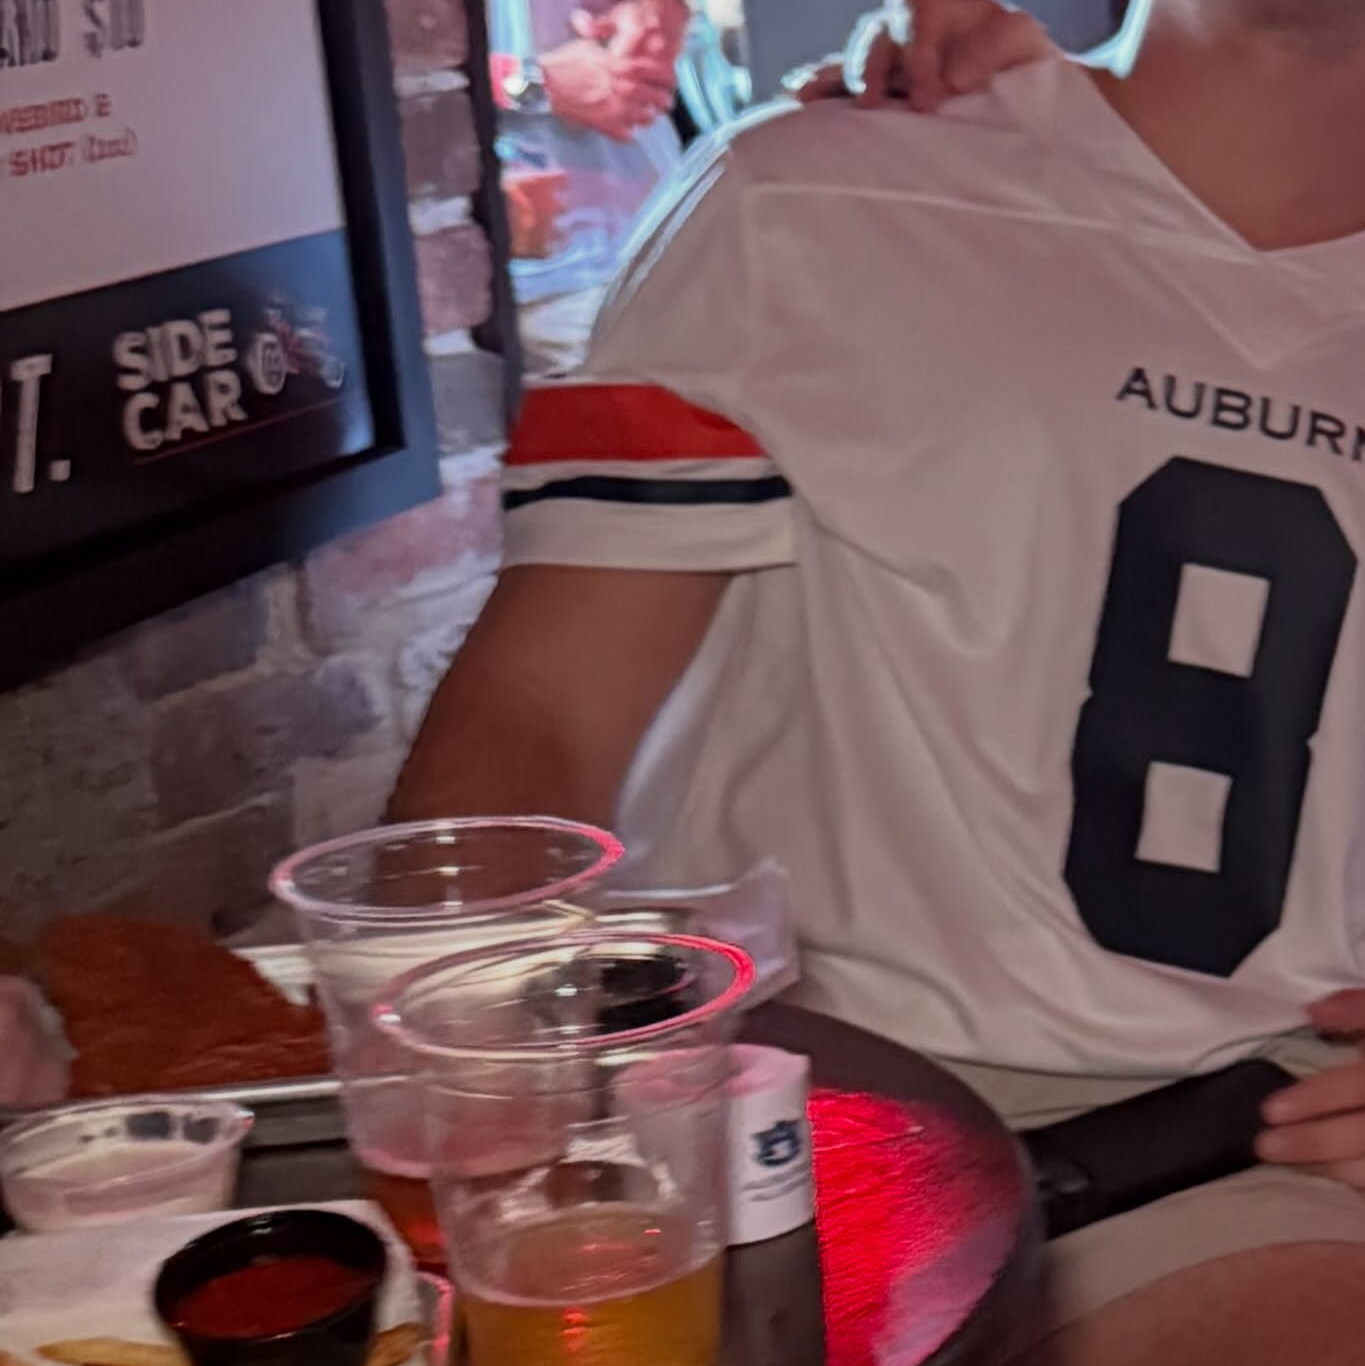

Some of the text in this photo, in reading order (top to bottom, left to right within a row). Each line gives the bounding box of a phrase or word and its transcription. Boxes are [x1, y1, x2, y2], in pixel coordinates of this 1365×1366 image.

[113, 307, 239, 391] SIDE
[122, 368, 249, 451] CAR
[1062, 455, 1358, 979] 8
